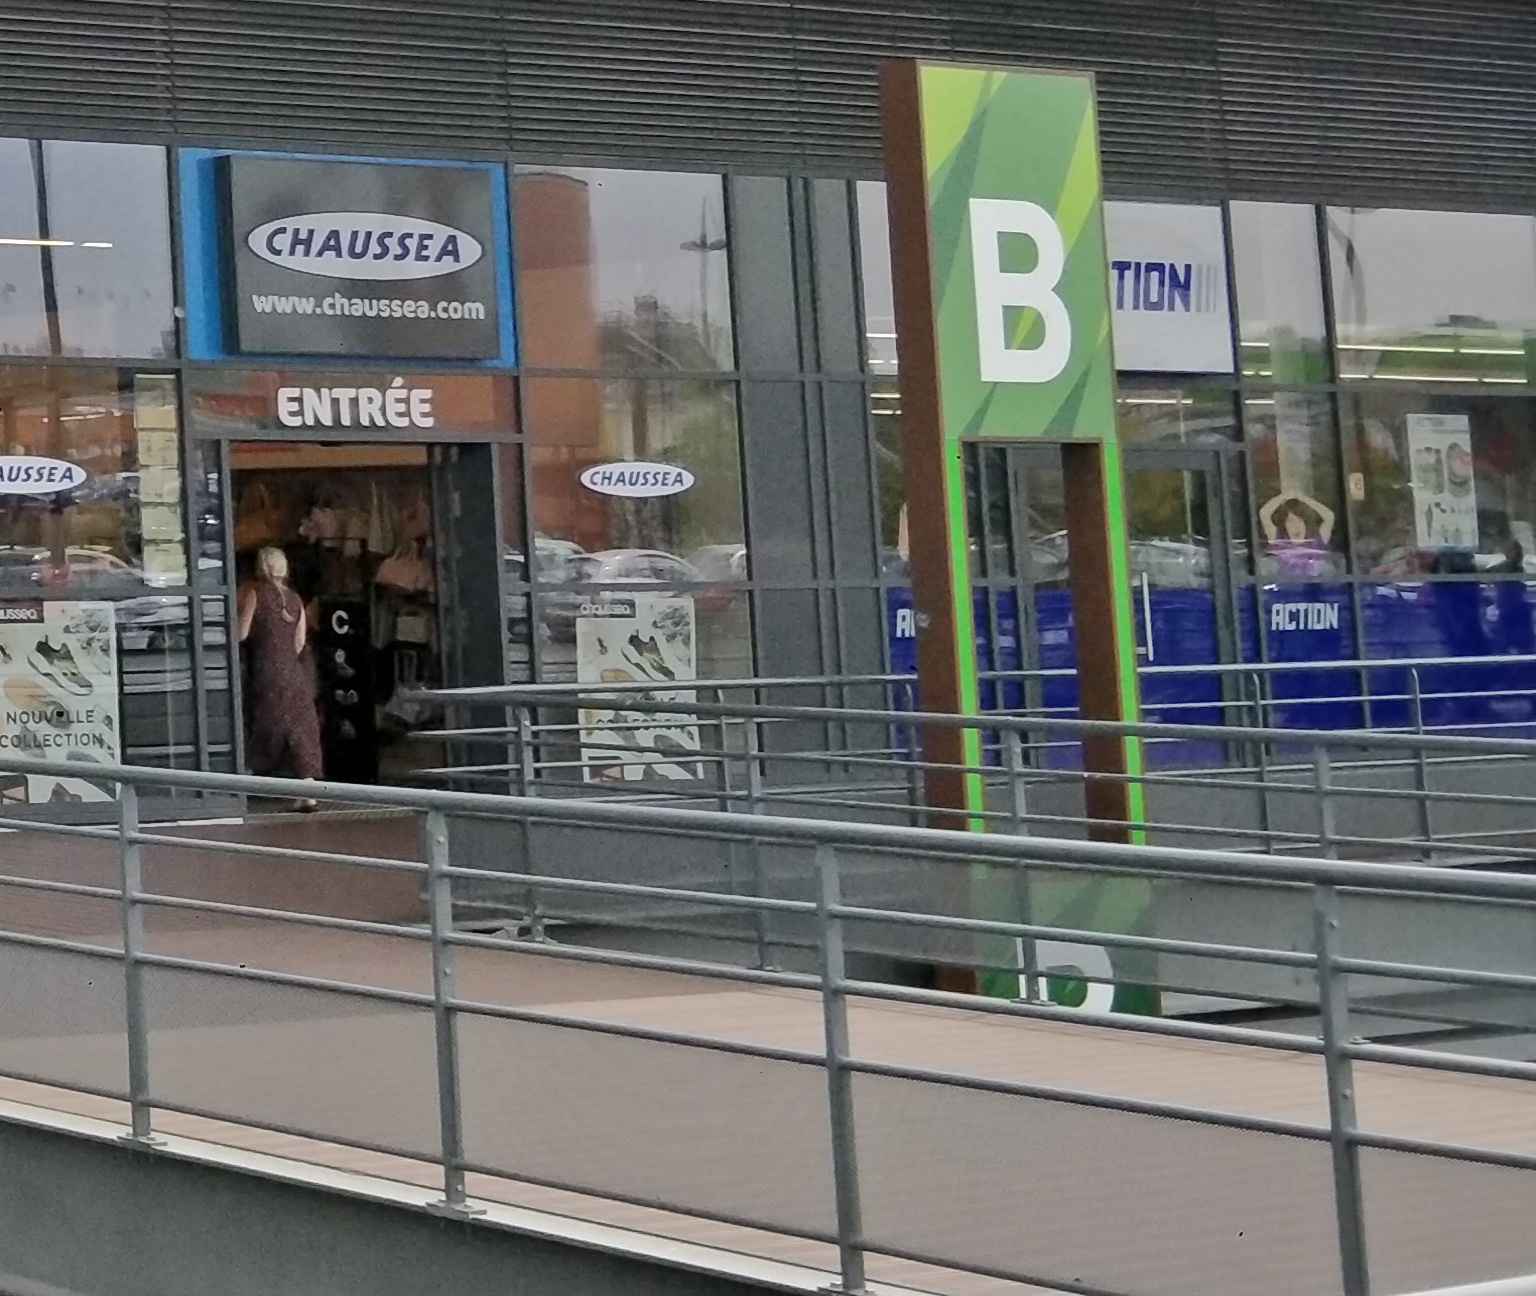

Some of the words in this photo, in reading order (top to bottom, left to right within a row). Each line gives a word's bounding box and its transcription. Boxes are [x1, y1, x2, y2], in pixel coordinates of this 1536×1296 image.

[265, 227, 462, 264] CHAUSSEA
[969, 198, 1071, 383] B
[1111, 260, 1192, 313] TION
[252, 292, 485, 320] www.chaussea.com
[277, 377, 435, 428] ENTRÉE
[589, 471, 685, 487] CHAUSSEA
[1271, 603, 1339, 631] ACTION
